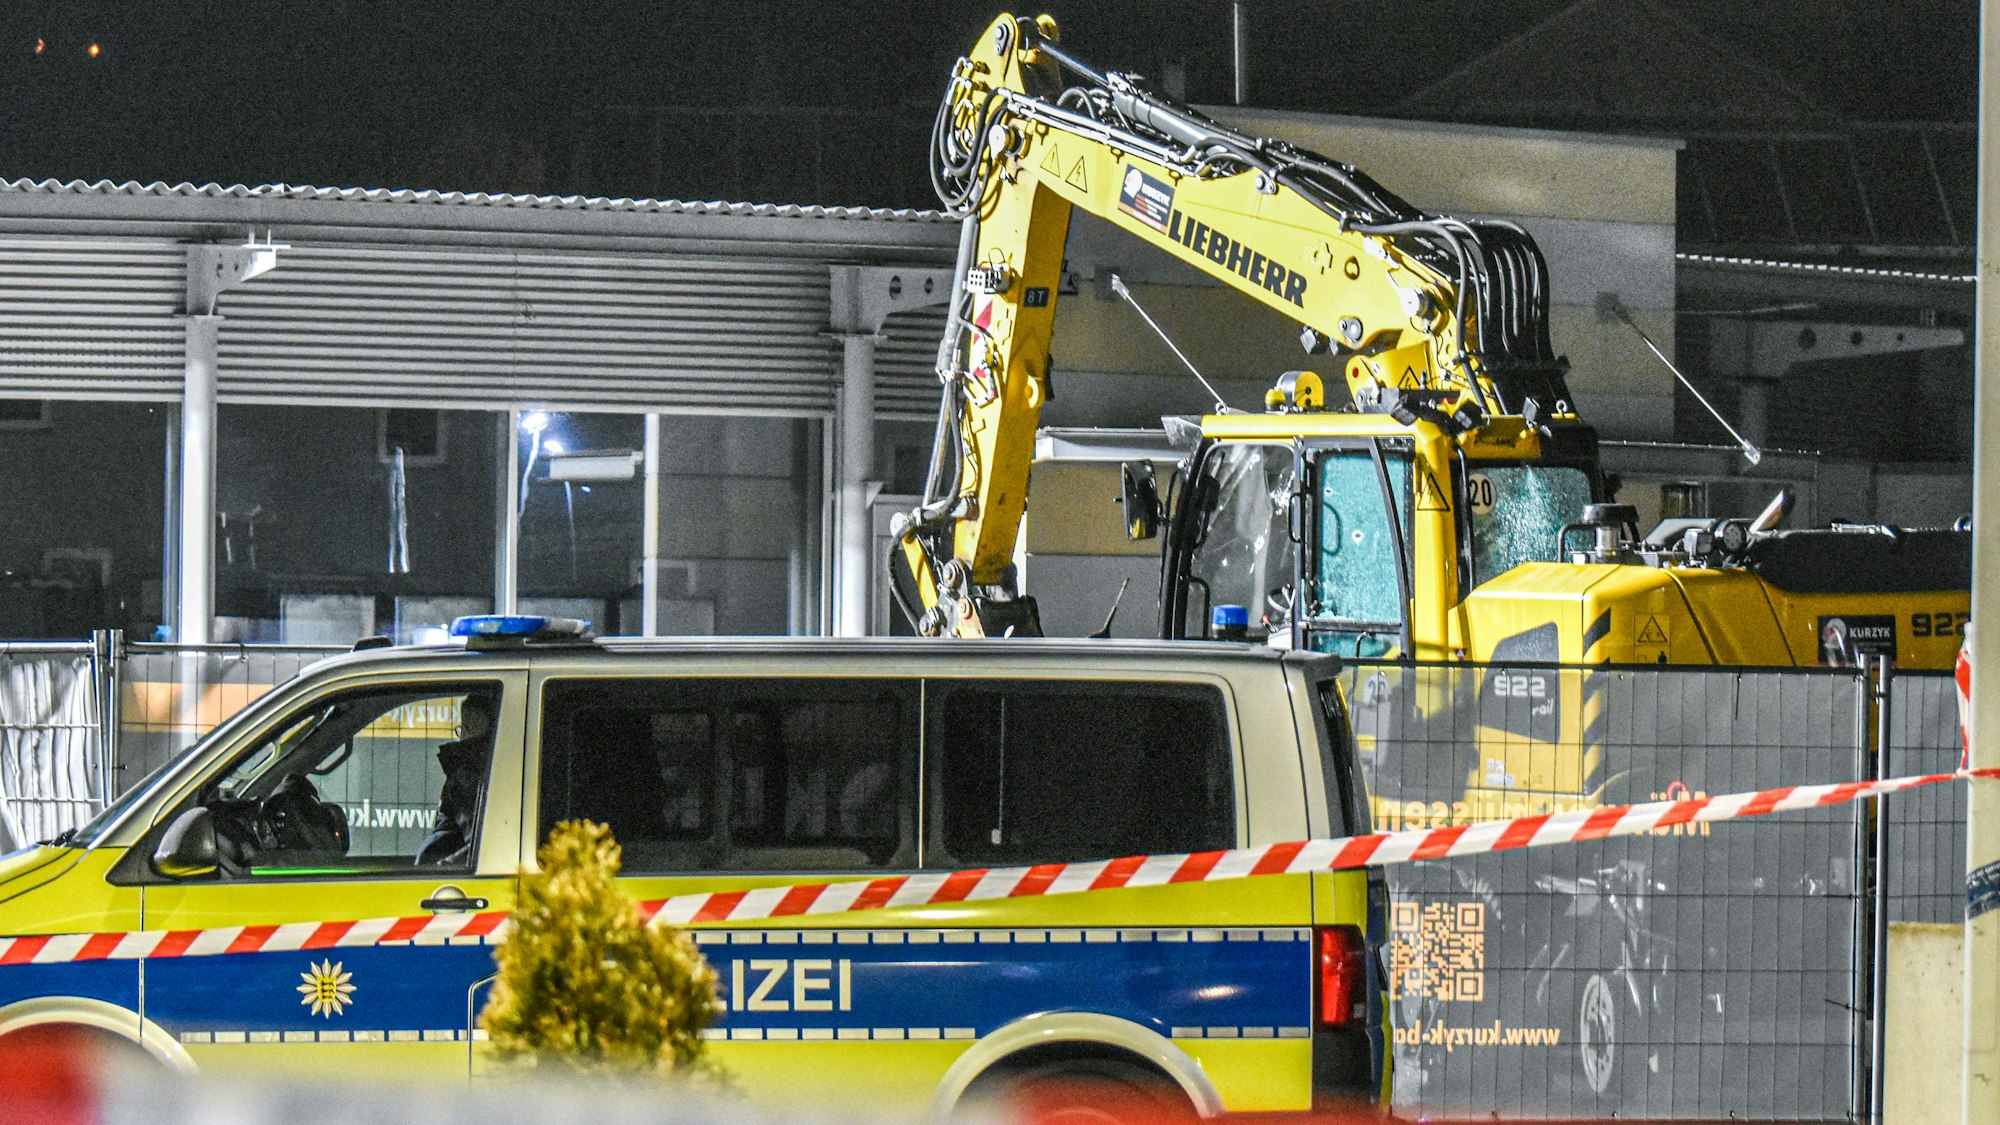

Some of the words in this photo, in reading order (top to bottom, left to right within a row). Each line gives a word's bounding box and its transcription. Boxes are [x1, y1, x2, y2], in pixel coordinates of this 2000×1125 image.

[1169, 208, 1307, 309] LIEBHERR
[1467, 479, 1492, 506] 20
[1849, 627, 1891, 638] KURZYK
[1494, 675, 1546, 697] 922
[1532, 698, 1554, 716] rail
[713, 959, 852, 1011] IZEI
